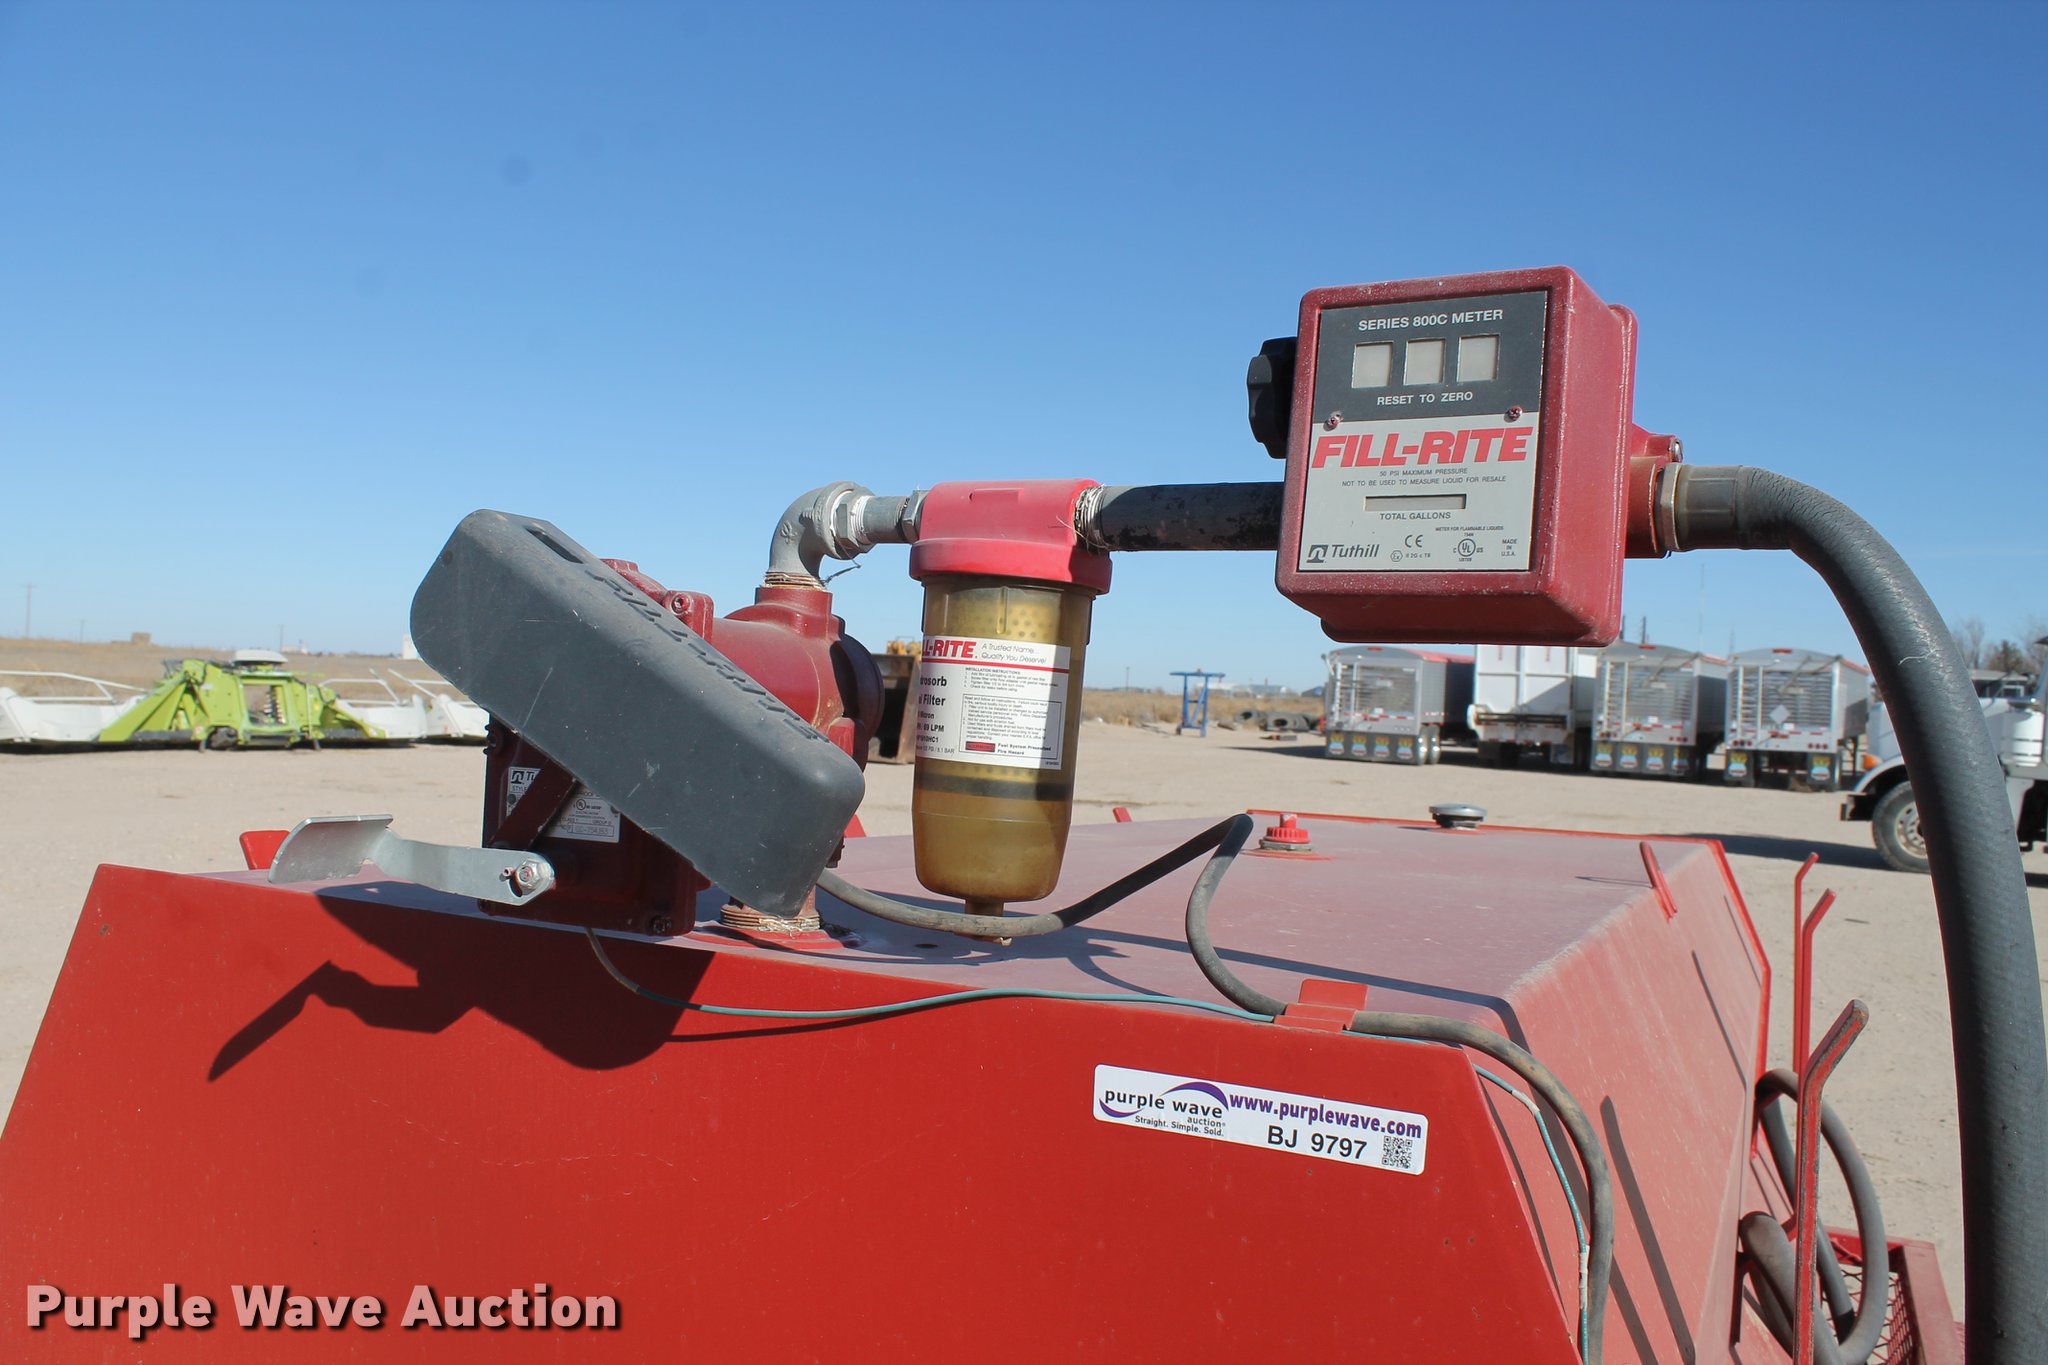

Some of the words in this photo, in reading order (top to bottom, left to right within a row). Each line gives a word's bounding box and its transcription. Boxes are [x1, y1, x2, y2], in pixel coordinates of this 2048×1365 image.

[1358, 317, 1410, 331] SERIES
[1412, 313, 1448, 327] 800C
[1452, 309, 1503, 324] METER
[1376, 394, 1414, 406] RESET
[1419, 393, 1436, 403] TO
[1440, 391, 1473, 403] ZERO
[1311, 426, 1533, 469] FILL-RITE
[1435, 467, 1468, 475] PRESSURE
[1379, 512, 1406, 521] TOTAL
[1408, 511, 1451, 520] GALLONS
[1332, 543, 1380, 558] Tuthill
[922, 639, 977, 659] L-RITE
[989, 643, 1013, 652] Trusted
[981, 652, 1005, 661] Quality
[1005, 653, 1019, 661] You
[923, 693, 946, 706] Filter
[930, 723, 945, 732] LPM
[1104, 1089, 1165, 1110] purple
[1172, 1100, 1223, 1119] wave
[1229, 1094, 1422, 1139] www.purplewave.com
[1134, 1115, 1169, 1128] Straight.
[1171, 1121, 1201, 1134] Simple.
[1203, 1126, 1225, 1137] Sold.
[1267, 1124, 1298, 1149] BJ
[1310, 1132, 1368, 1160] 9797
